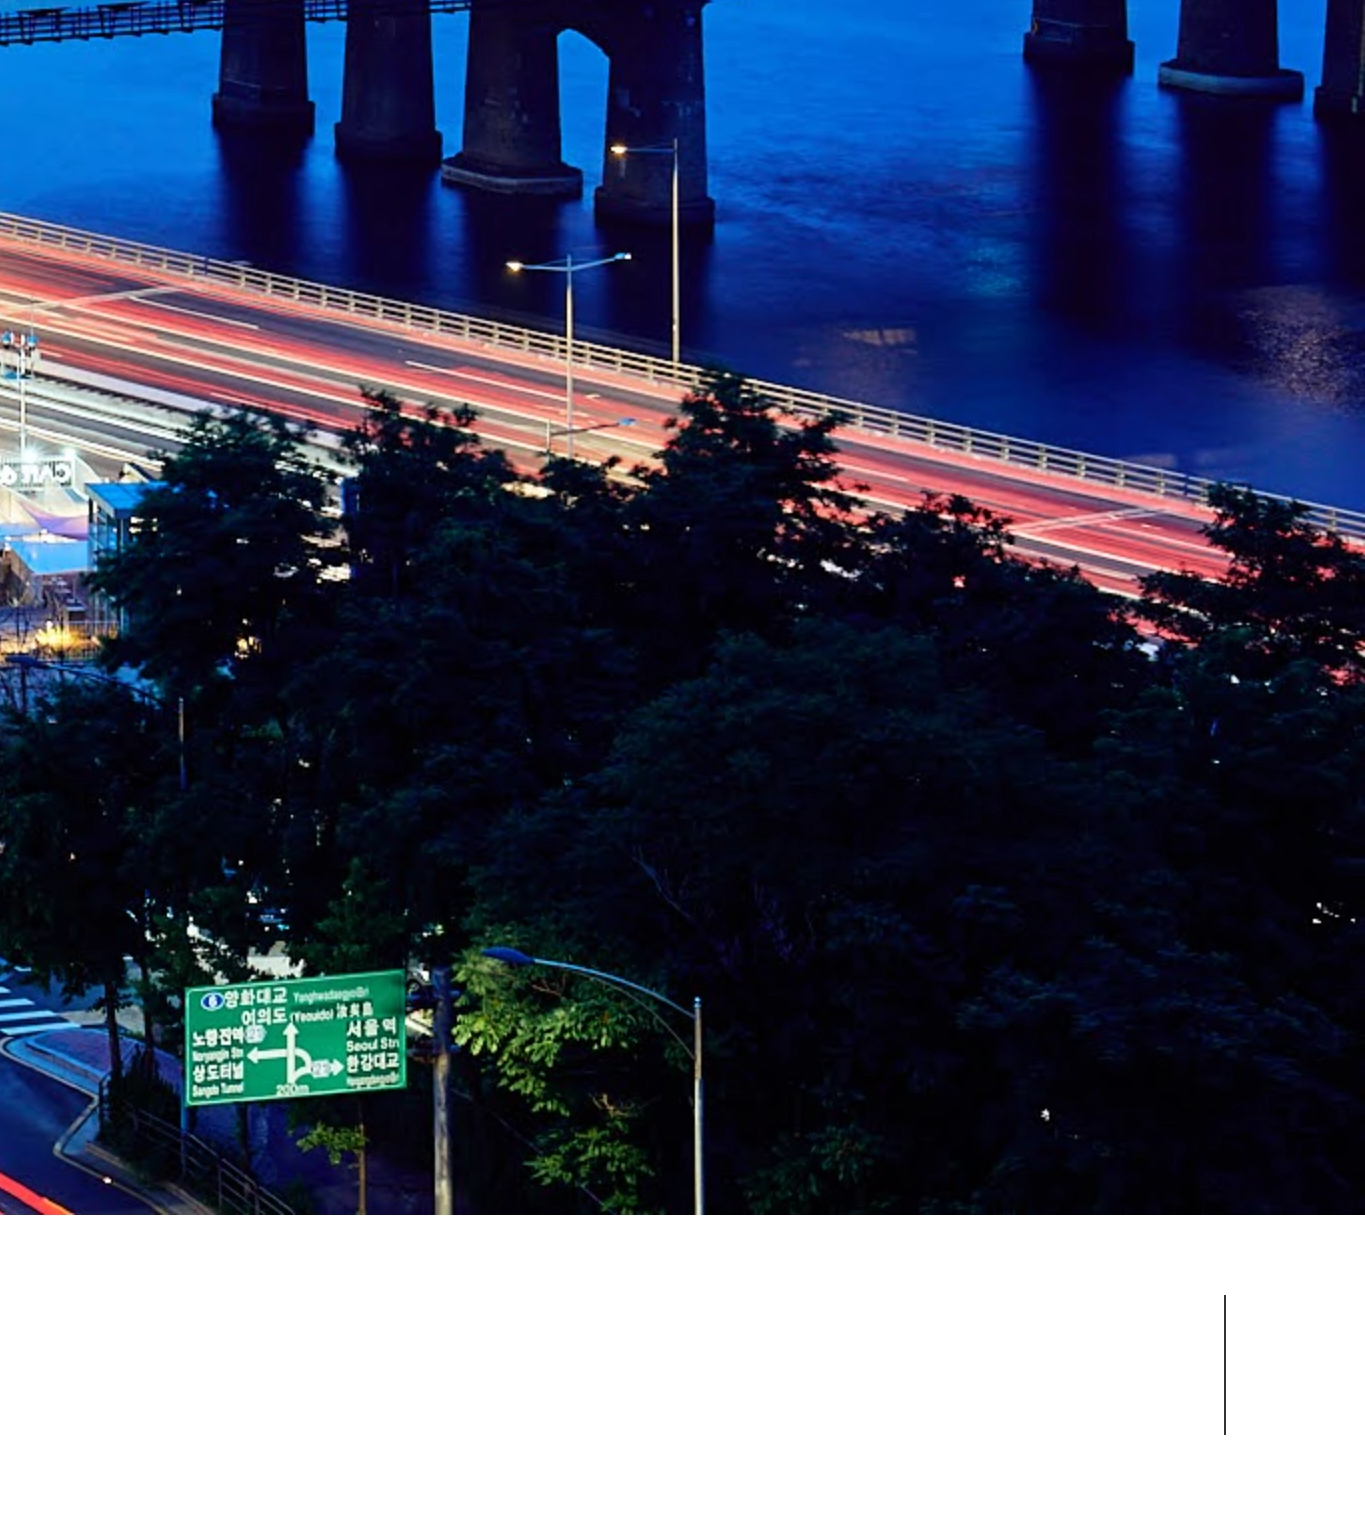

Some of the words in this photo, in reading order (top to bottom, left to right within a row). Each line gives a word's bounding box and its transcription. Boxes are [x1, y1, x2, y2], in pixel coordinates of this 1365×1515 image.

[224, 987, 287, 1009] 양화대교
[241, 1007, 287, 1026] 여의도
[192, 1026, 244, 1047] 노량진역
[346, 1039, 378, 1053] Seoul
[380, 1036, 399, 1050] Stn
[192, 1061, 244, 1084] 상도터널
[346, 1051, 400, 1073] 한강대교
[276, 1084, 310, 1096] 200m
